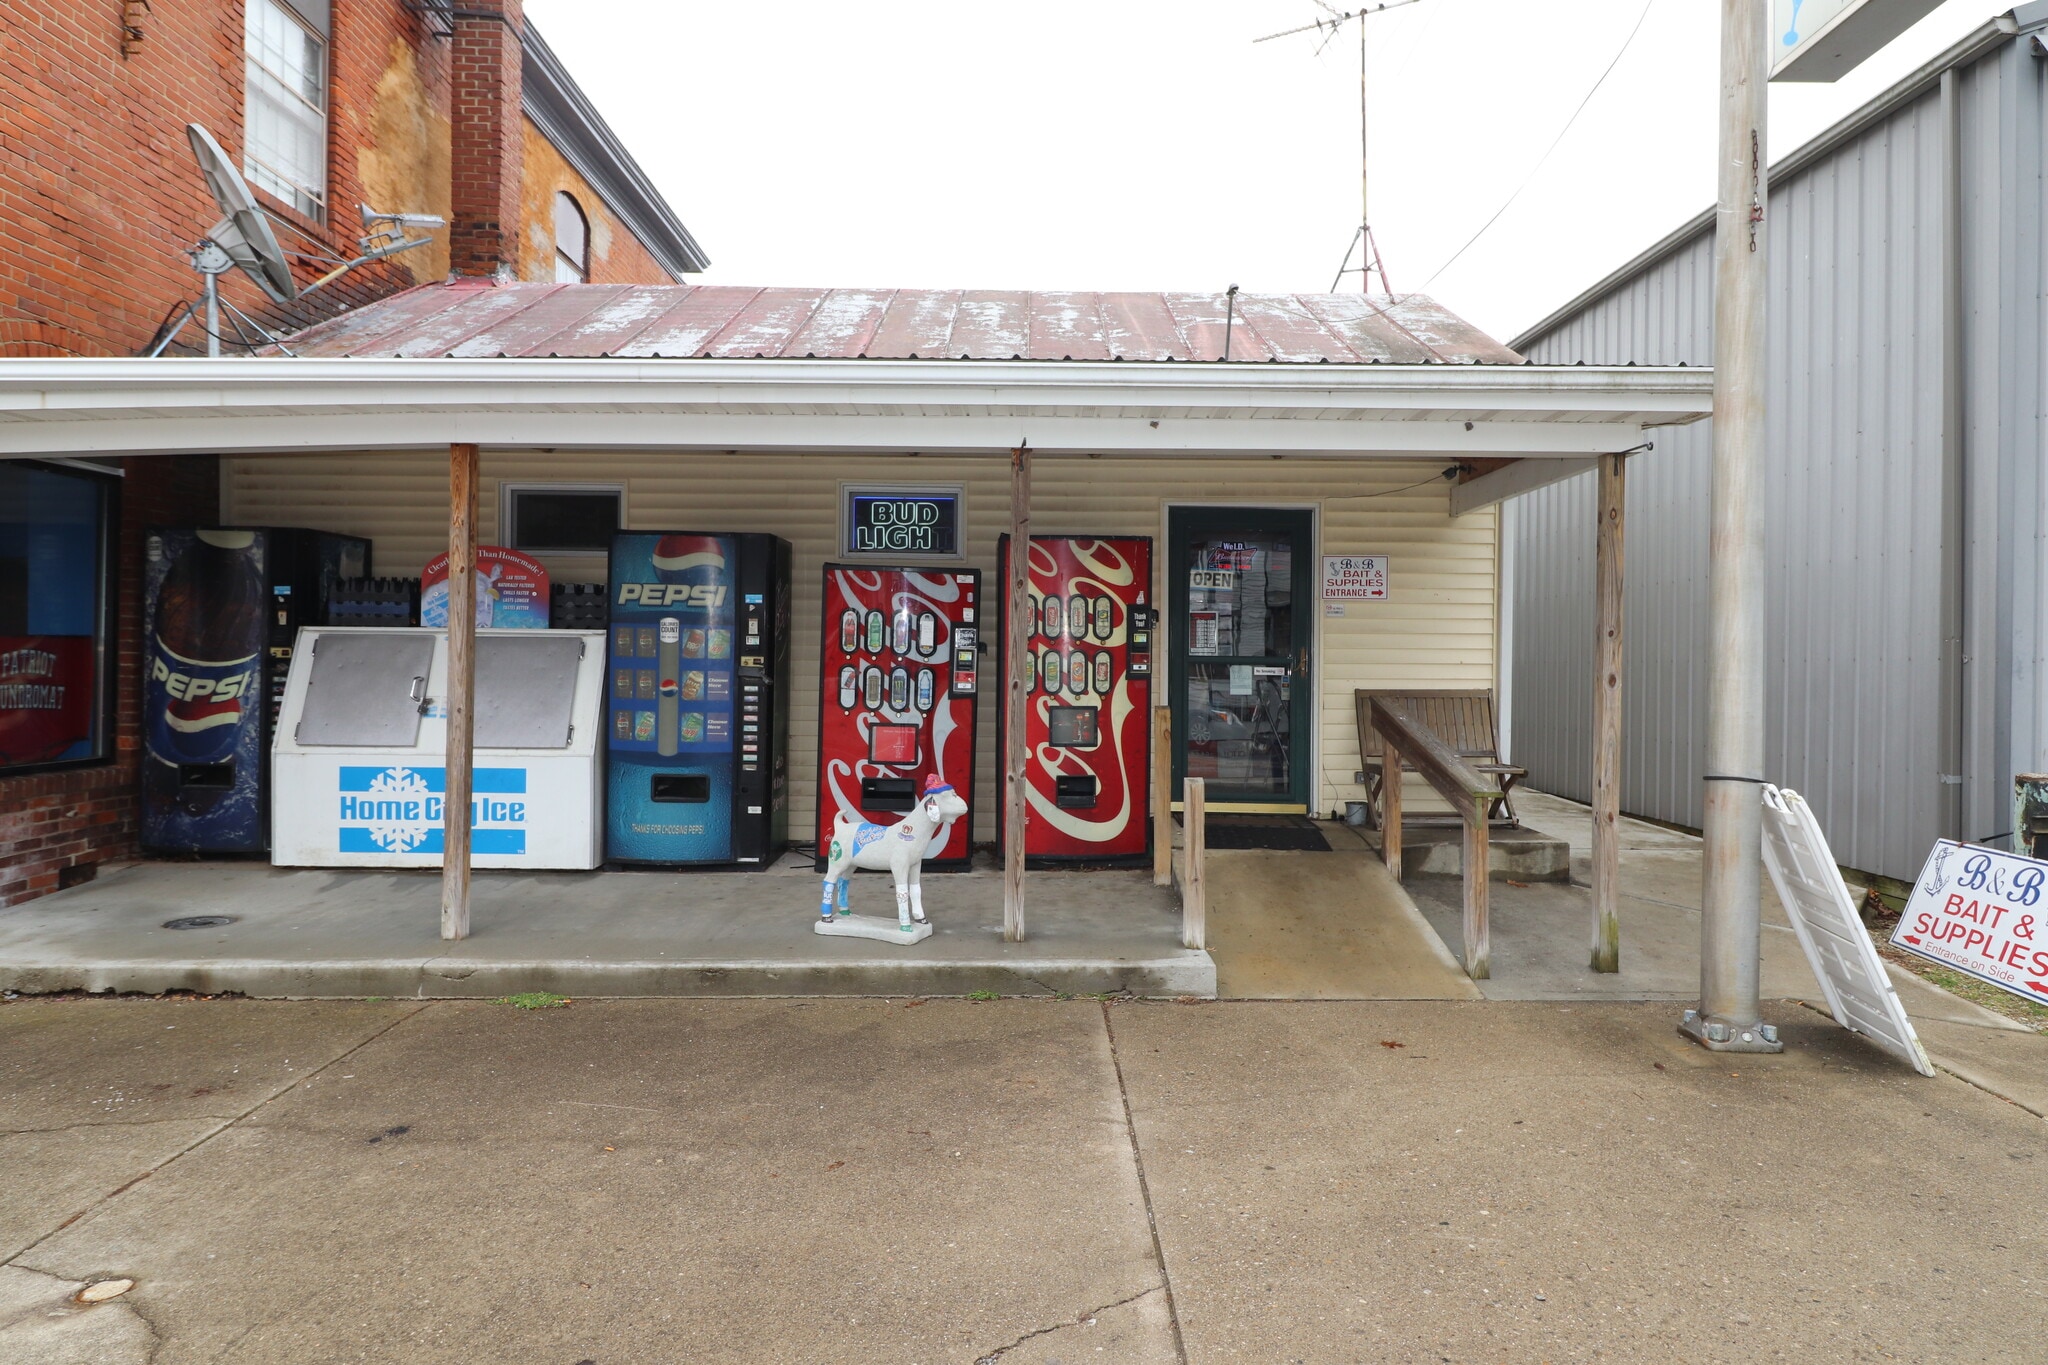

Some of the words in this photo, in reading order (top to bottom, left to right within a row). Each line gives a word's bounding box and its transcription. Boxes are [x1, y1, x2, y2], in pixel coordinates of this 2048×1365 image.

[872, 502, 939, 525] BUD
[427, 558, 450, 575] Clearl
[478, 549, 498, 559] Than
[1193, 571, 1232, 587] OPEN
[1326, 579, 1384, 587] SUPPLIES
[1343, 570, 1371, 578] BAIT
[1374, 570, 1383, 578] &
[618, 584, 728, 607] PEPSI
[1325, 588, 1368, 597] ENTRANCE
[1134, 612, 1147, 620] Thank
[2, 649, 57, 678] PATRIOT
[152, 655, 250, 703] PEPSI
[340, 796, 420, 820] Home
[482, 797, 525, 822] Ice
[632, 824, 650, 834] THANKS
[650, 825, 661, 834] FOR
[661, 825, 688, 835] CHOOSING
[1943, 893, 2009, 929] BAIT
[2013, 914, 2036, 941] &
[1913, 912, 2048, 977] SUPPLIES
[1924, 941, 1969, 966] Entrance
[1971, 958, 1985, 973] on
[1988, 964, 2016, 984] Side
